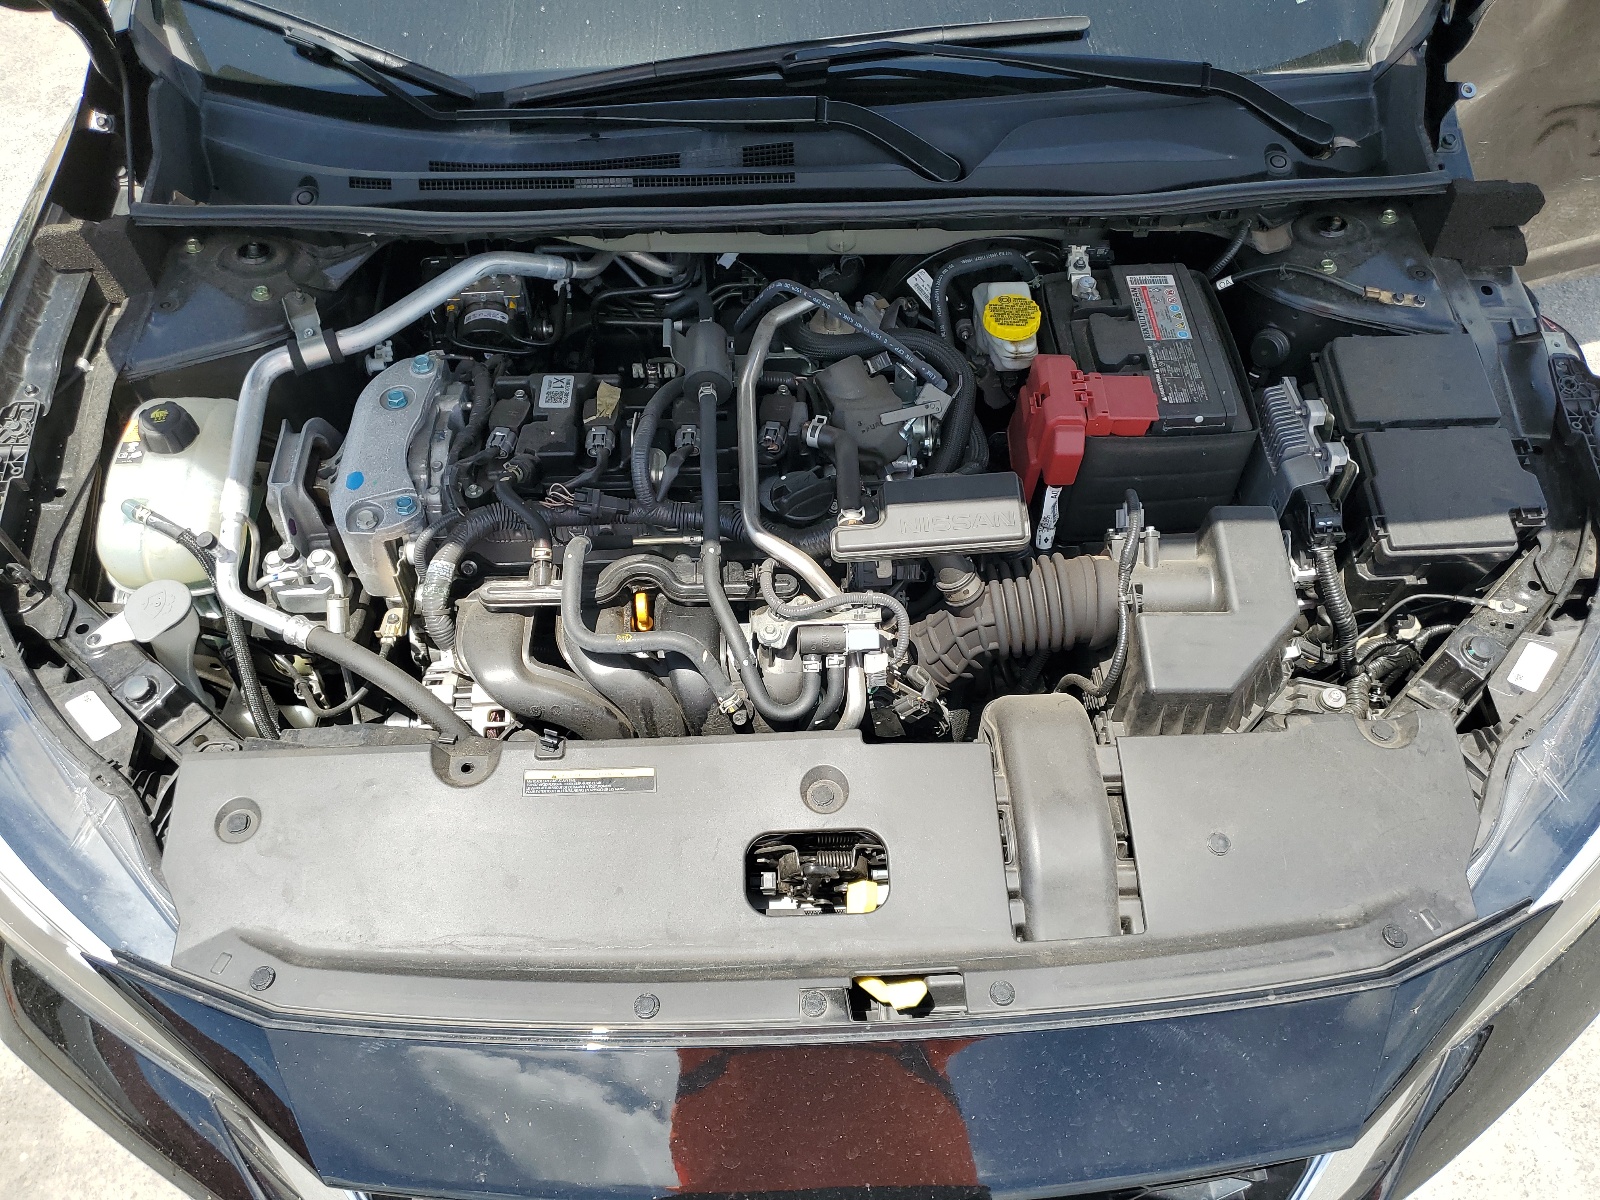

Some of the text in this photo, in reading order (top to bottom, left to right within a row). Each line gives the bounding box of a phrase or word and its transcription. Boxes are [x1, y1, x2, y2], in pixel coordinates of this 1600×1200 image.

[1130, 287, 1143, 314] NISSAN
[1138, 315, 1151, 340] RENAULT
[552, 377, 566, 389] X1
[900, 510, 1016, 535] NISSAN
